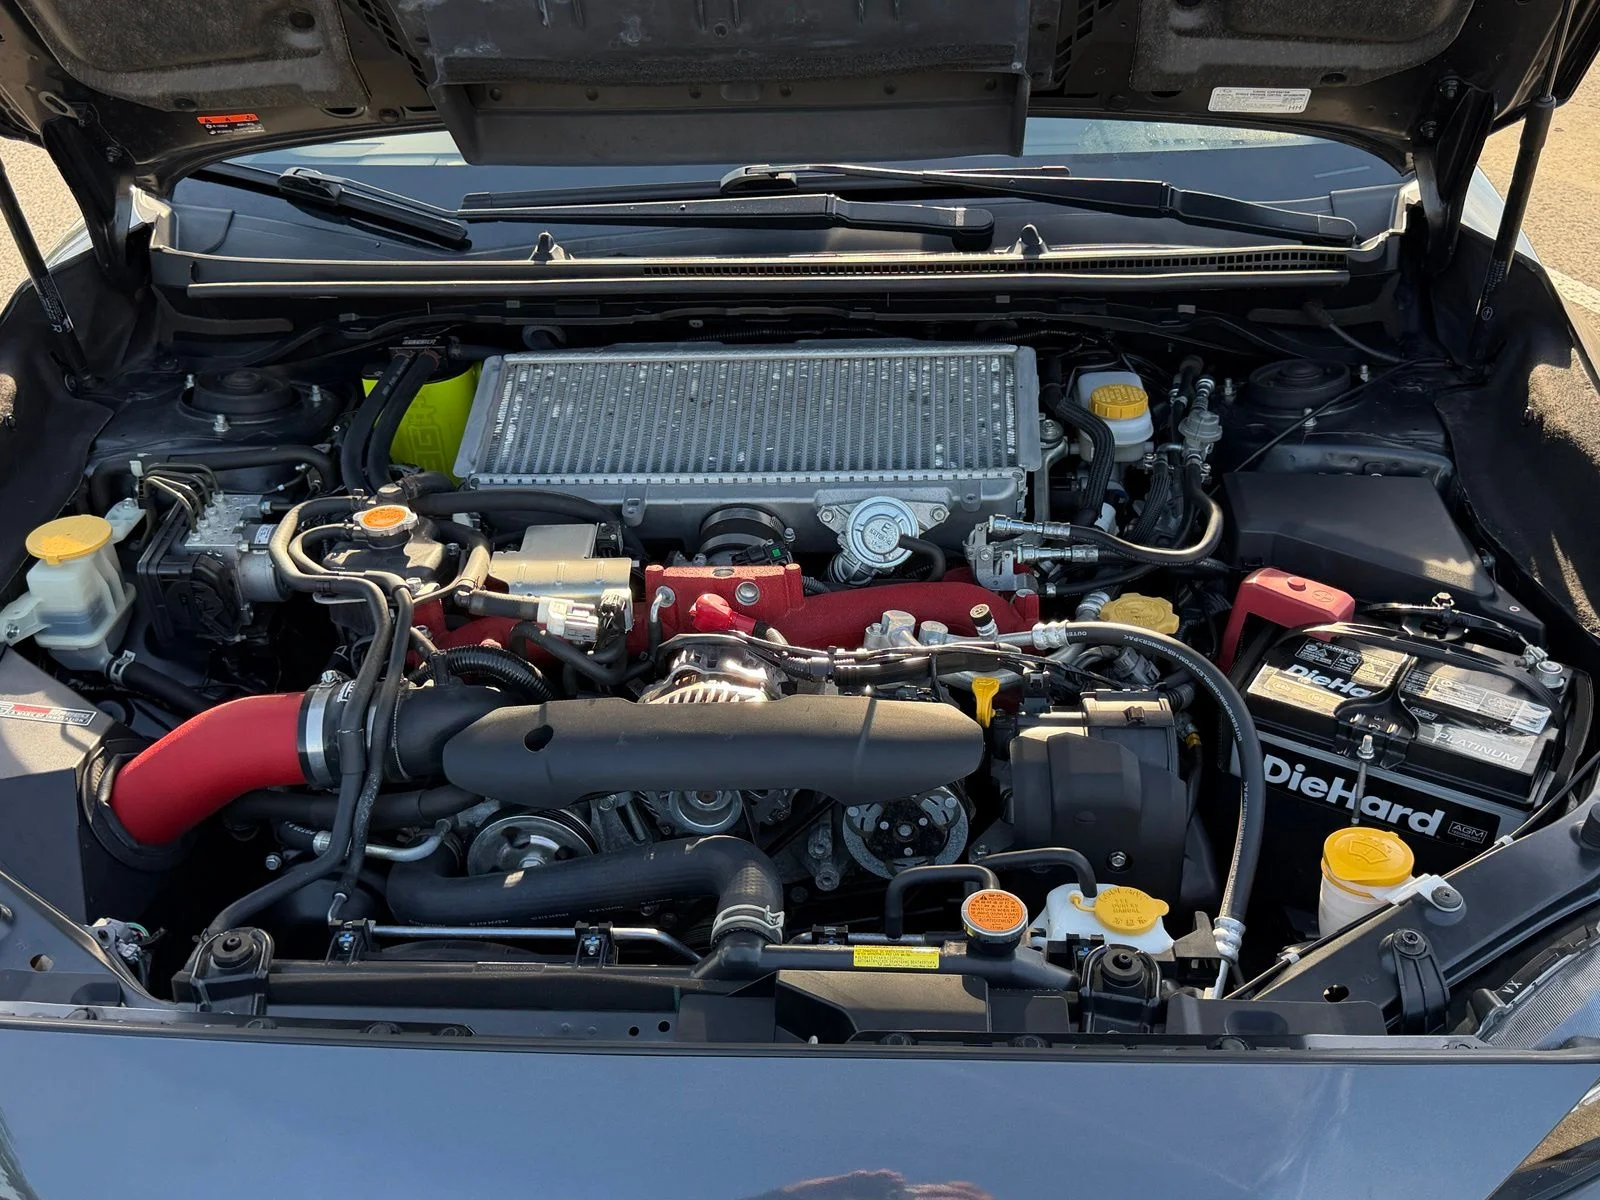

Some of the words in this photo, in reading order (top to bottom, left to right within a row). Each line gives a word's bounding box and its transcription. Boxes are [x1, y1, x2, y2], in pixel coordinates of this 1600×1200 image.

[1283, 663, 1372, 698] DieHa
[1436, 732, 1520, 764] PLATINUM
[1452, 824, 1485, 838] AGM
